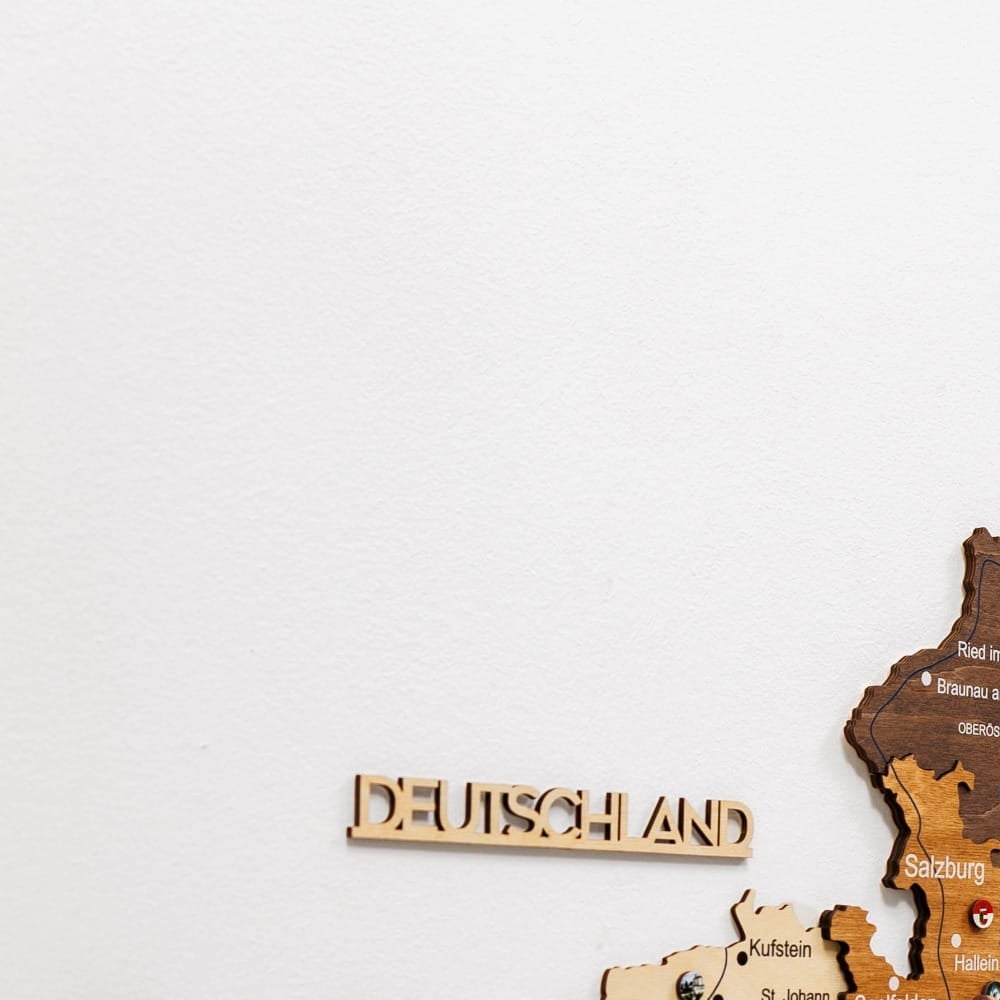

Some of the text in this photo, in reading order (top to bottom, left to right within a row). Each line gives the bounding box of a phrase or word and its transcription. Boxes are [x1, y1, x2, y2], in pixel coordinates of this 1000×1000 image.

[958, 641, 986, 661] Ried
[937, 678, 988, 700] Braunau
[348, 774, 755, 858] DEUTSCHLAND
[904, 853, 985, 886] Salzburg
[749, 938, 812, 959] Kufstein
[954, 954, 1000, 972] Hallein
